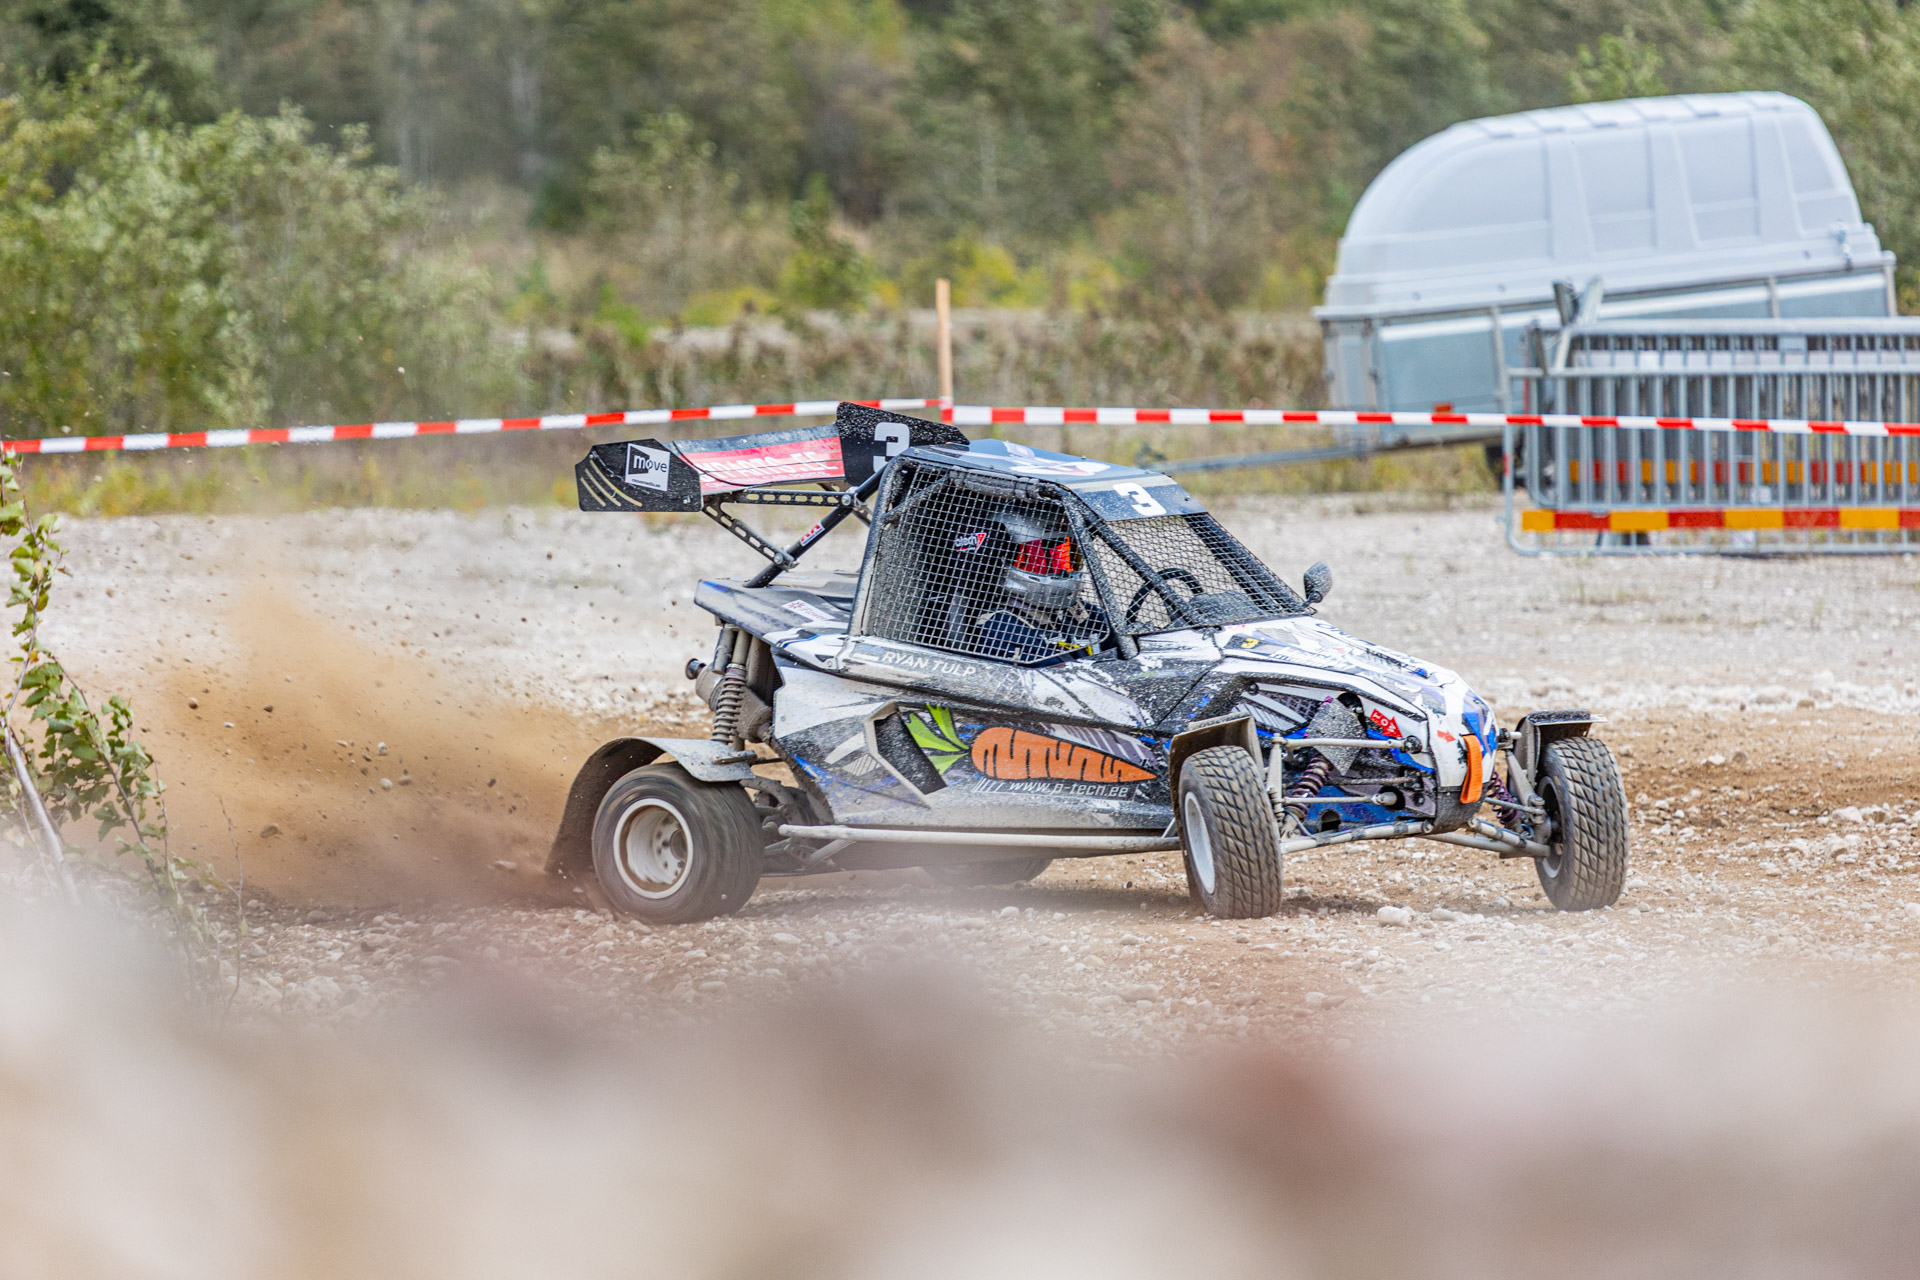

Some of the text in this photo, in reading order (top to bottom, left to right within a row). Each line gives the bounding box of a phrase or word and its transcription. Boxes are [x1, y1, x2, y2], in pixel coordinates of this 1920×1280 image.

[873, 422, 910, 473] 3
[633, 455, 667, 473] move
[1112, 482, 1167, 517] 3
[881, 650, 977, 678] RYAN TULP
[1372, 711, 1398, 734] TOW
